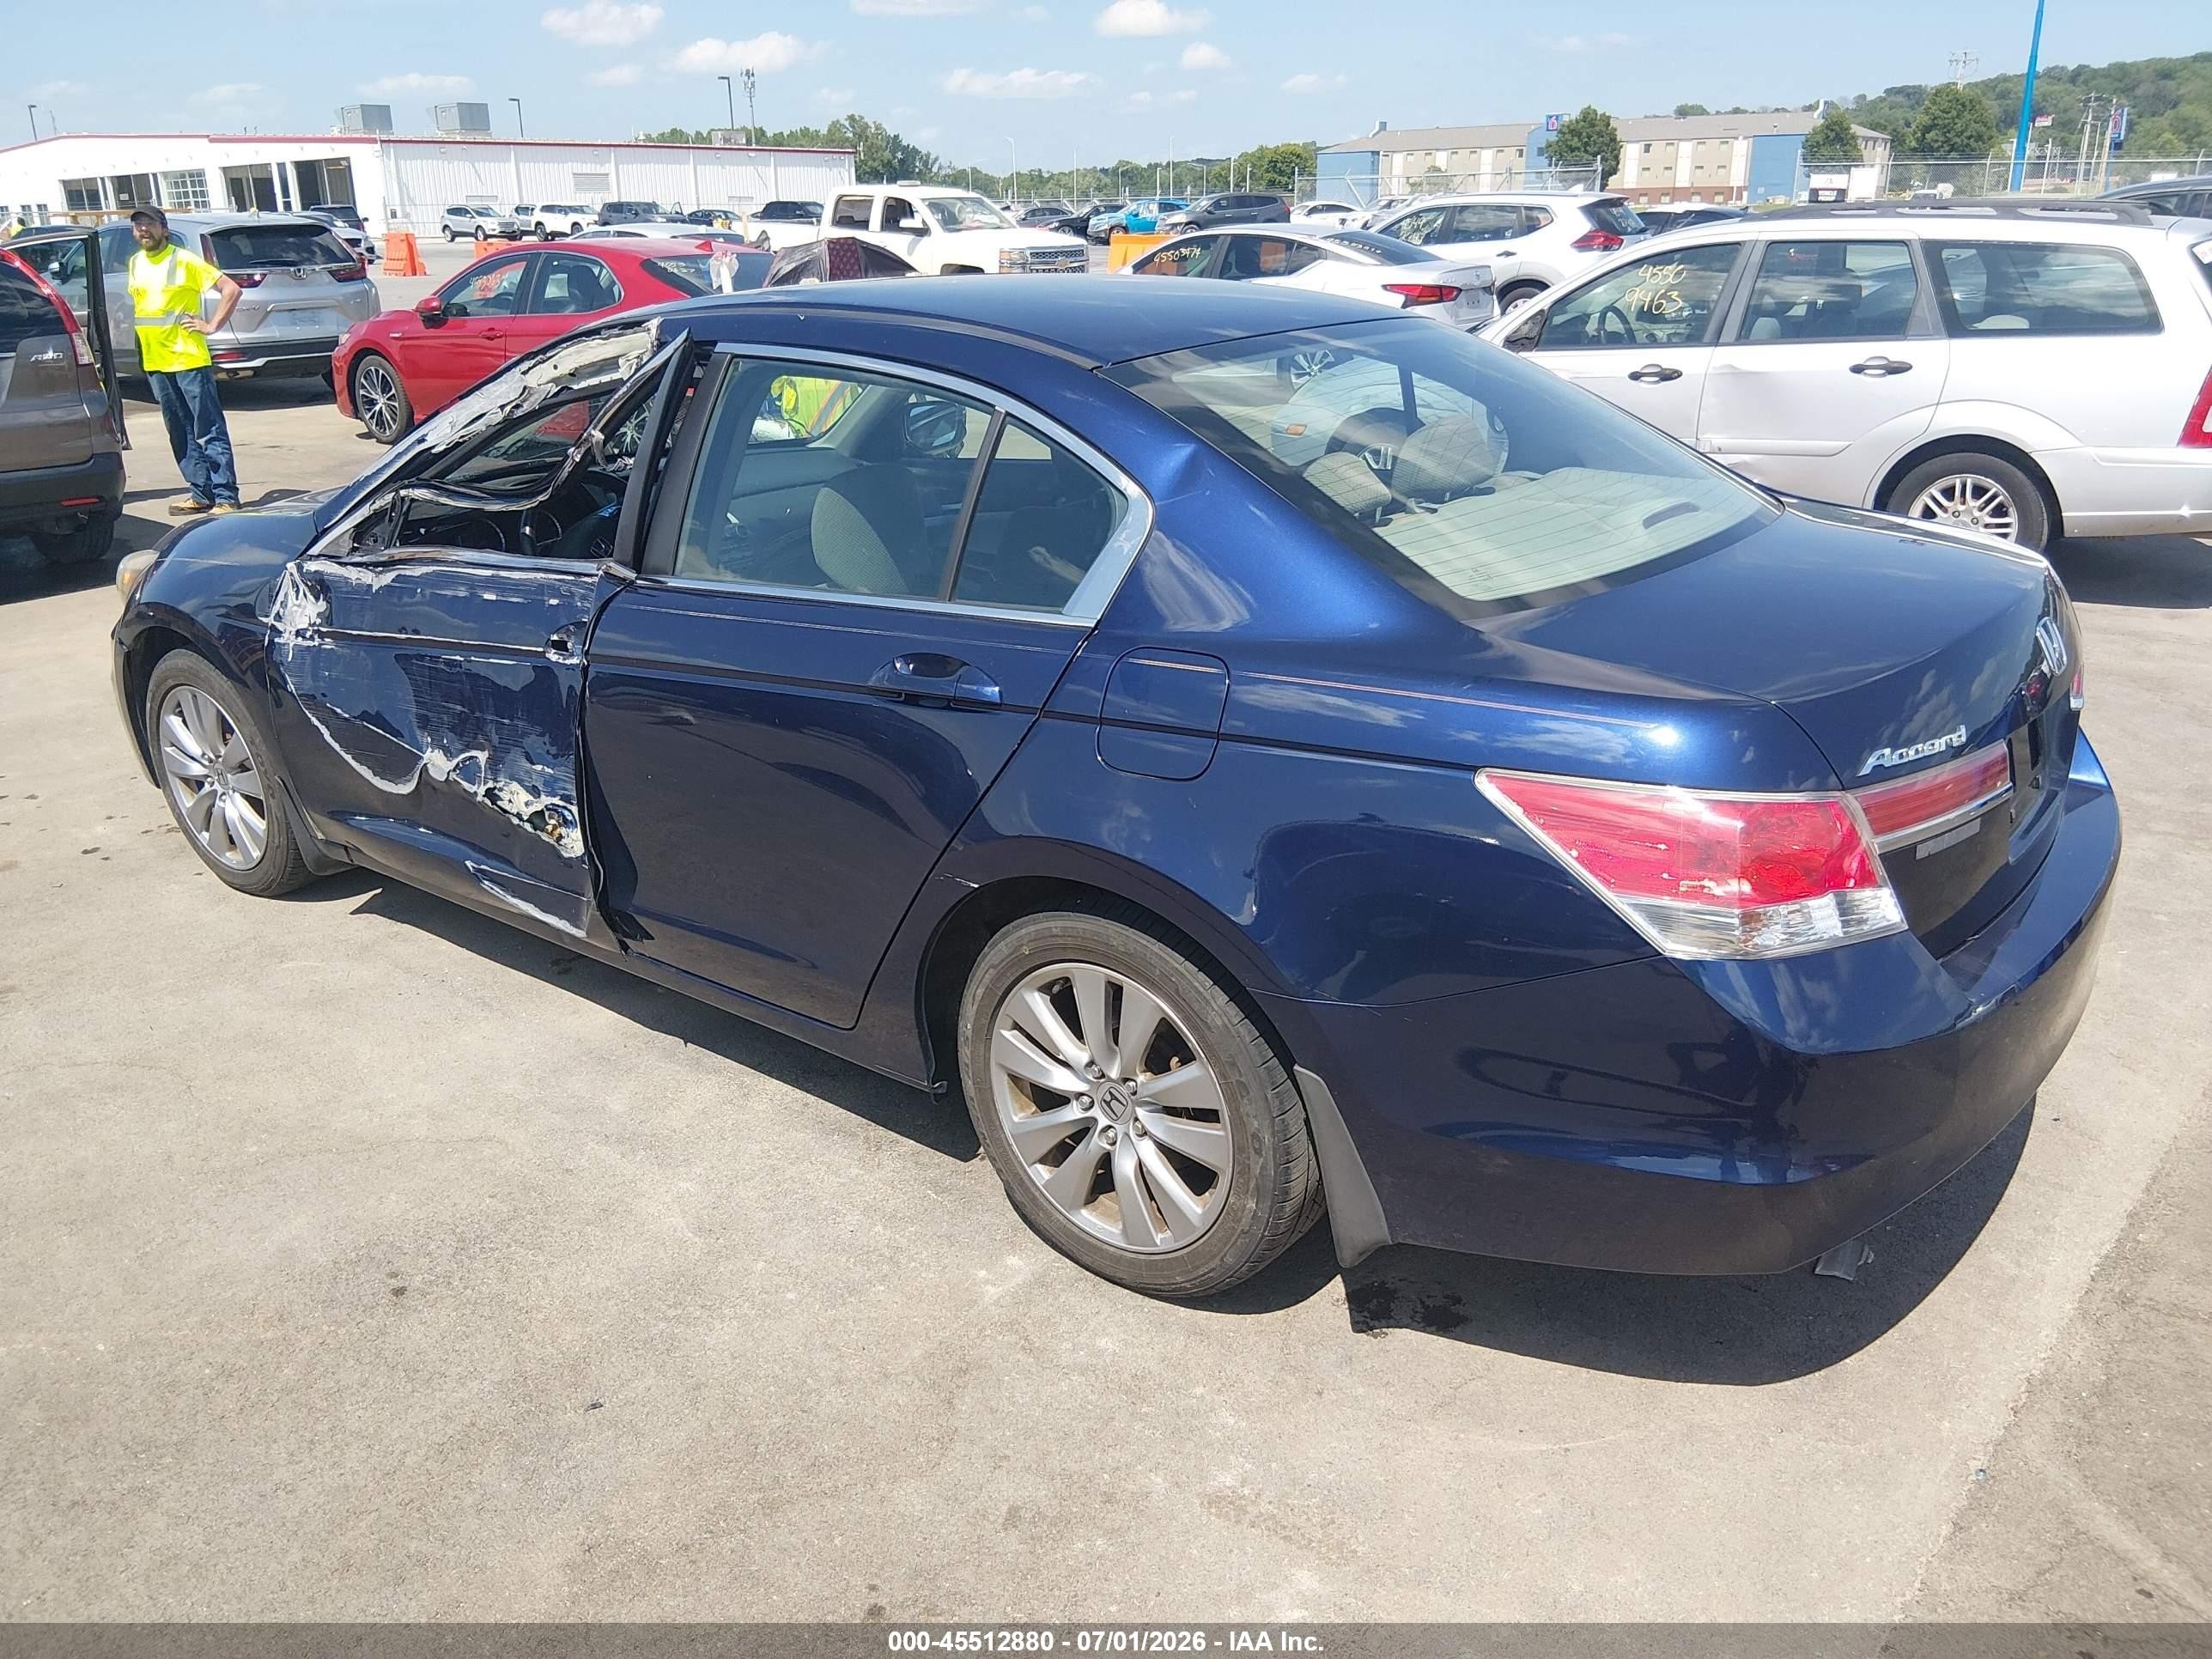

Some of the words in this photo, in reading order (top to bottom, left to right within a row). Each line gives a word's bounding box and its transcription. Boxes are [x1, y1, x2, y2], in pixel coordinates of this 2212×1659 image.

[1638, 262, 1686, 285] 4550
[1625, 288, 1683, 314] 9463
[1856, 725, 1966, 777] Accord
